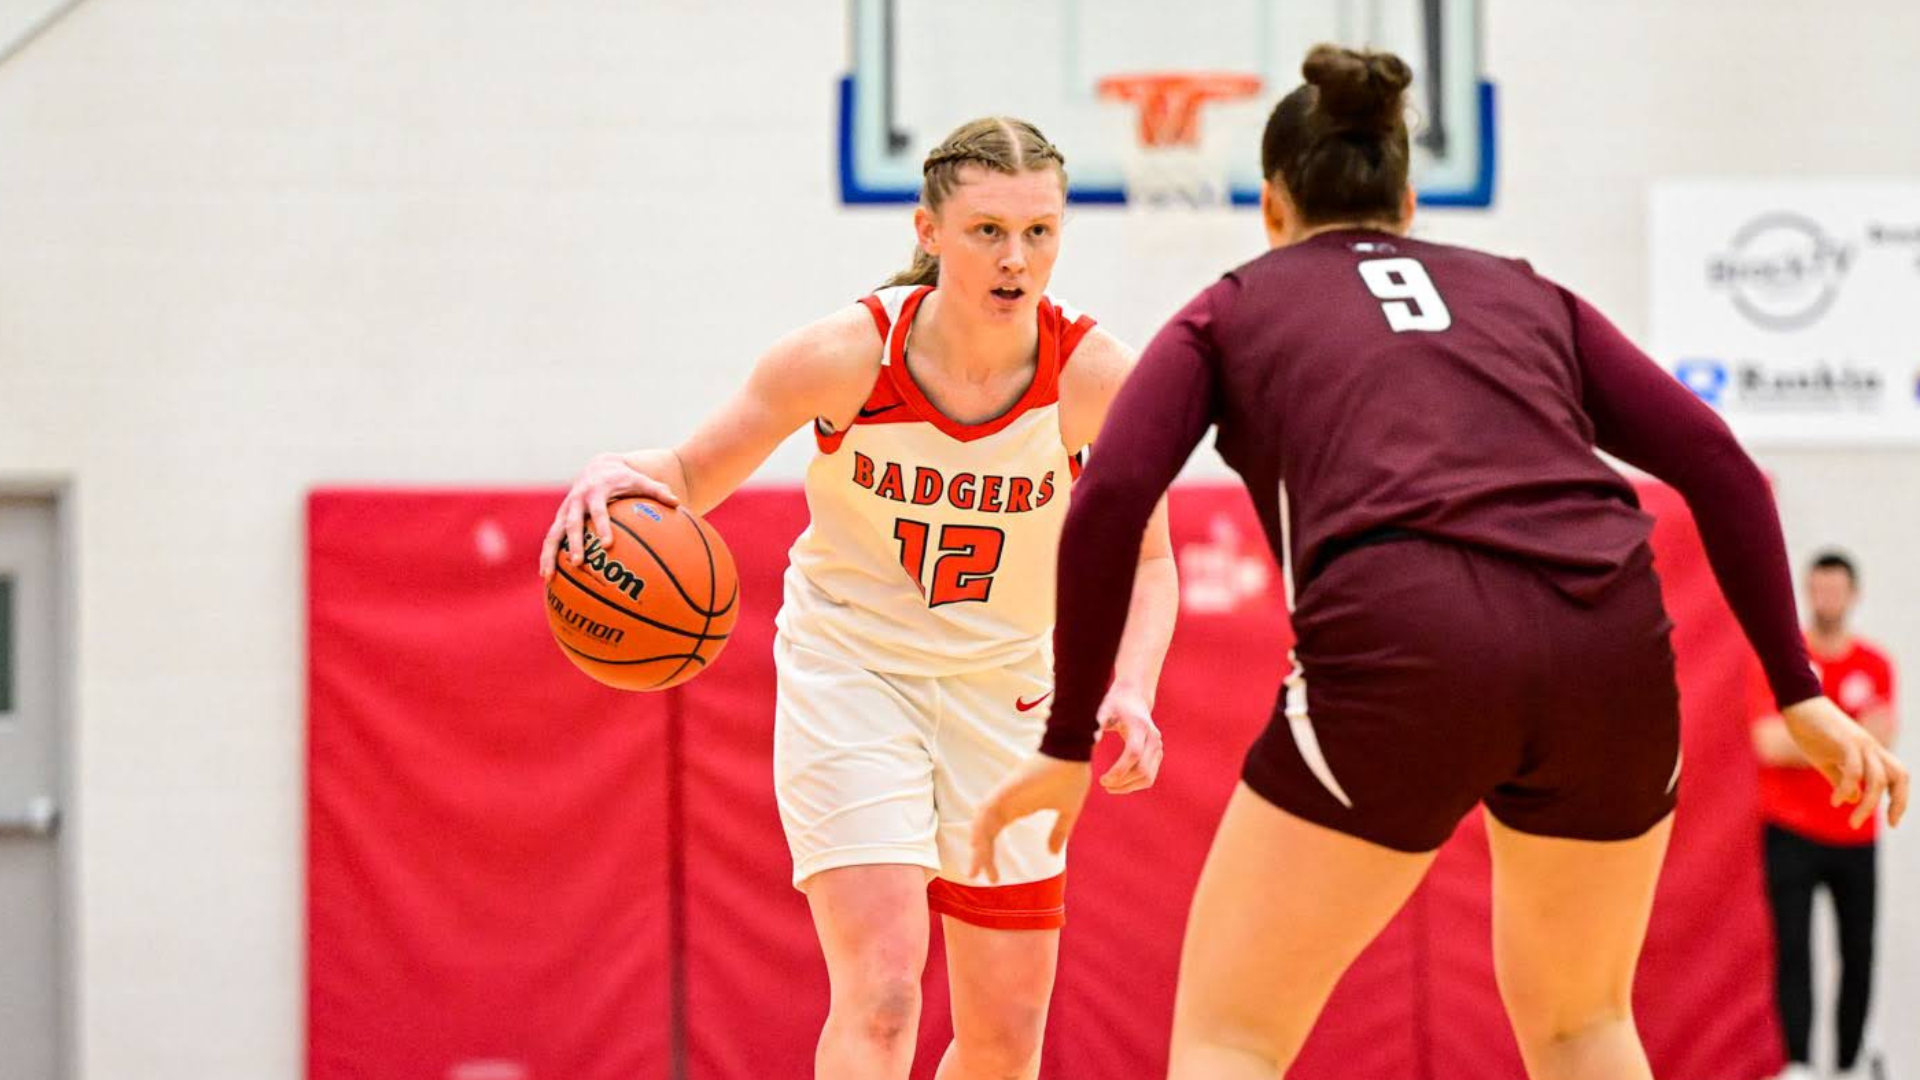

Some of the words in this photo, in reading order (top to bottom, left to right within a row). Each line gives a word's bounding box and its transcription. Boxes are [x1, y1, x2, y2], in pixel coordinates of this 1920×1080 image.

[1357, 257, 1452, 333] 9
[852, 450, 1055, 513] BADGERS
[893, 517, 1005, 609] 12
